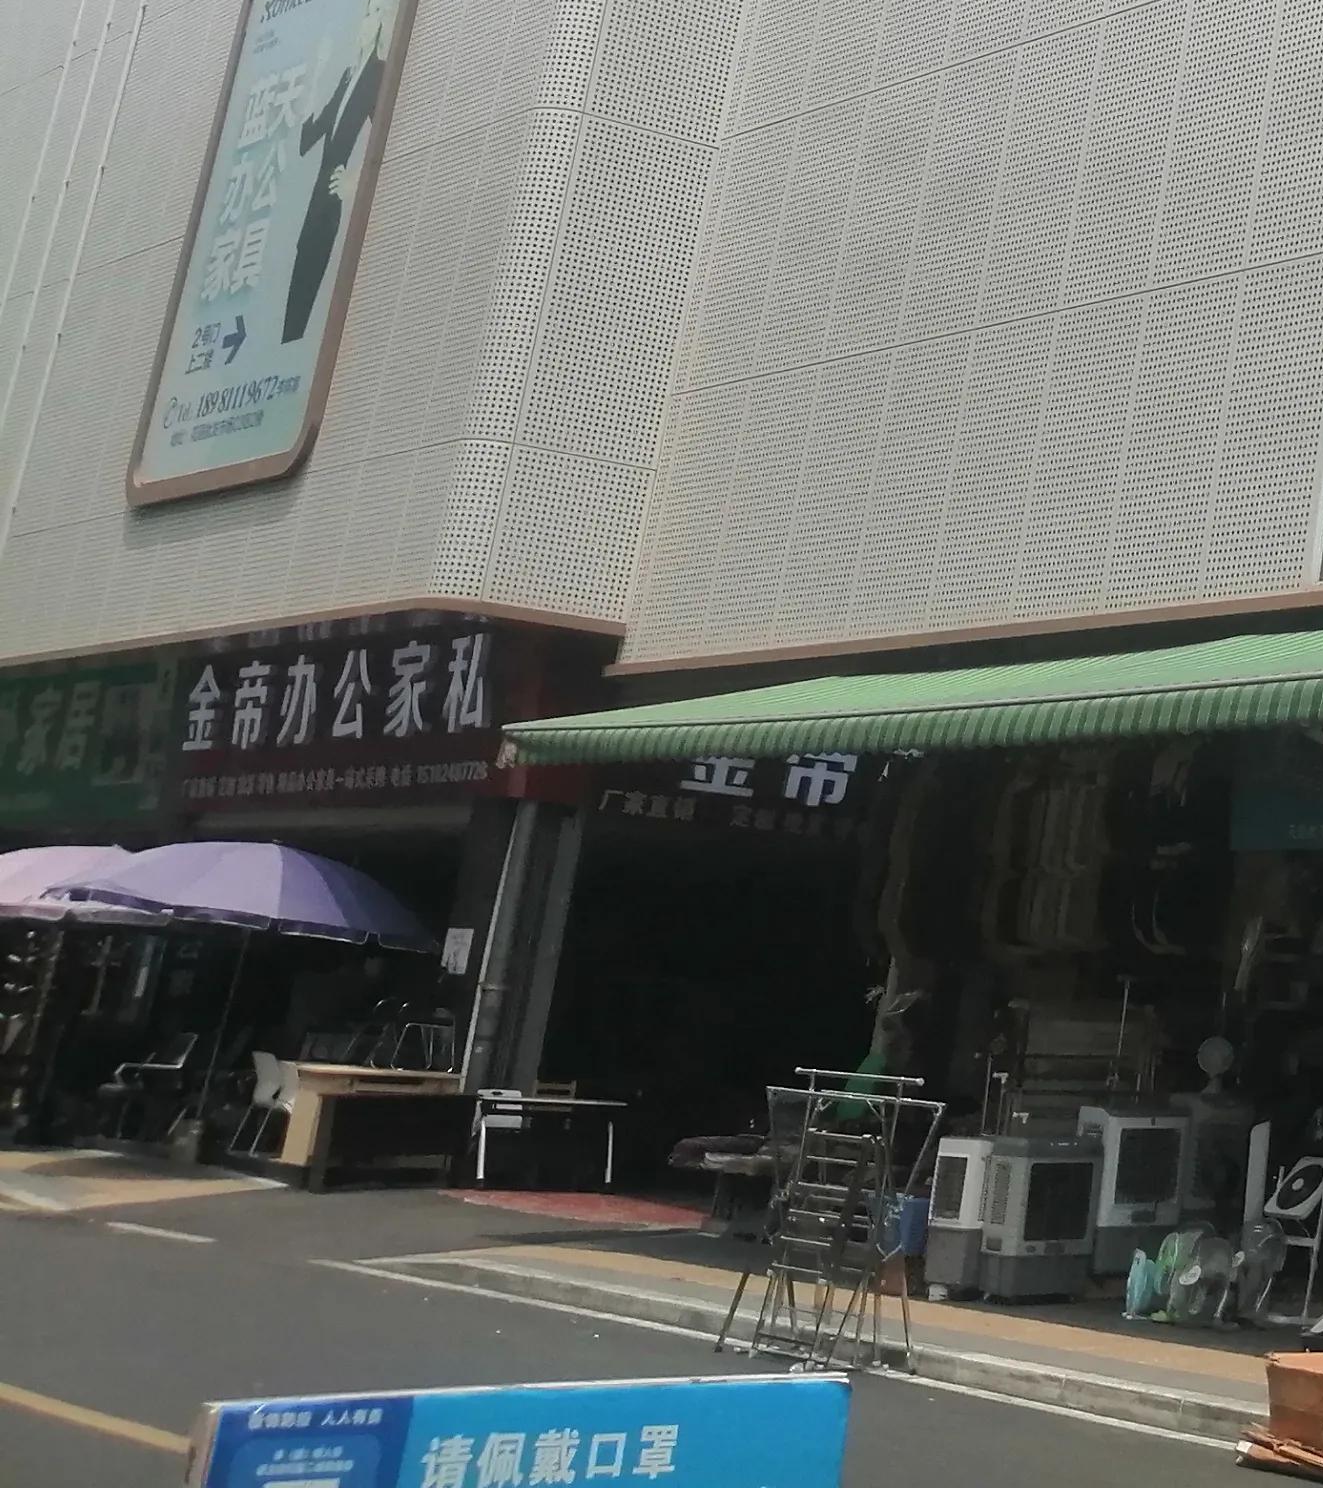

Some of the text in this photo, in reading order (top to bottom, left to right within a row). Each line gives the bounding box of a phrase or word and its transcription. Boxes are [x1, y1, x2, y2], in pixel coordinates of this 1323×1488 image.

[238, 63, 307, 149] 蓝天
[219, 139, 286, 226] 办公
[200, 218, 271, 302] 家具
[0, 680, 100, 775] 家居
[182, 632, 492, 752] 金帝办公家私
[420, 1423, 681, 1488] 请佩戴口罩
